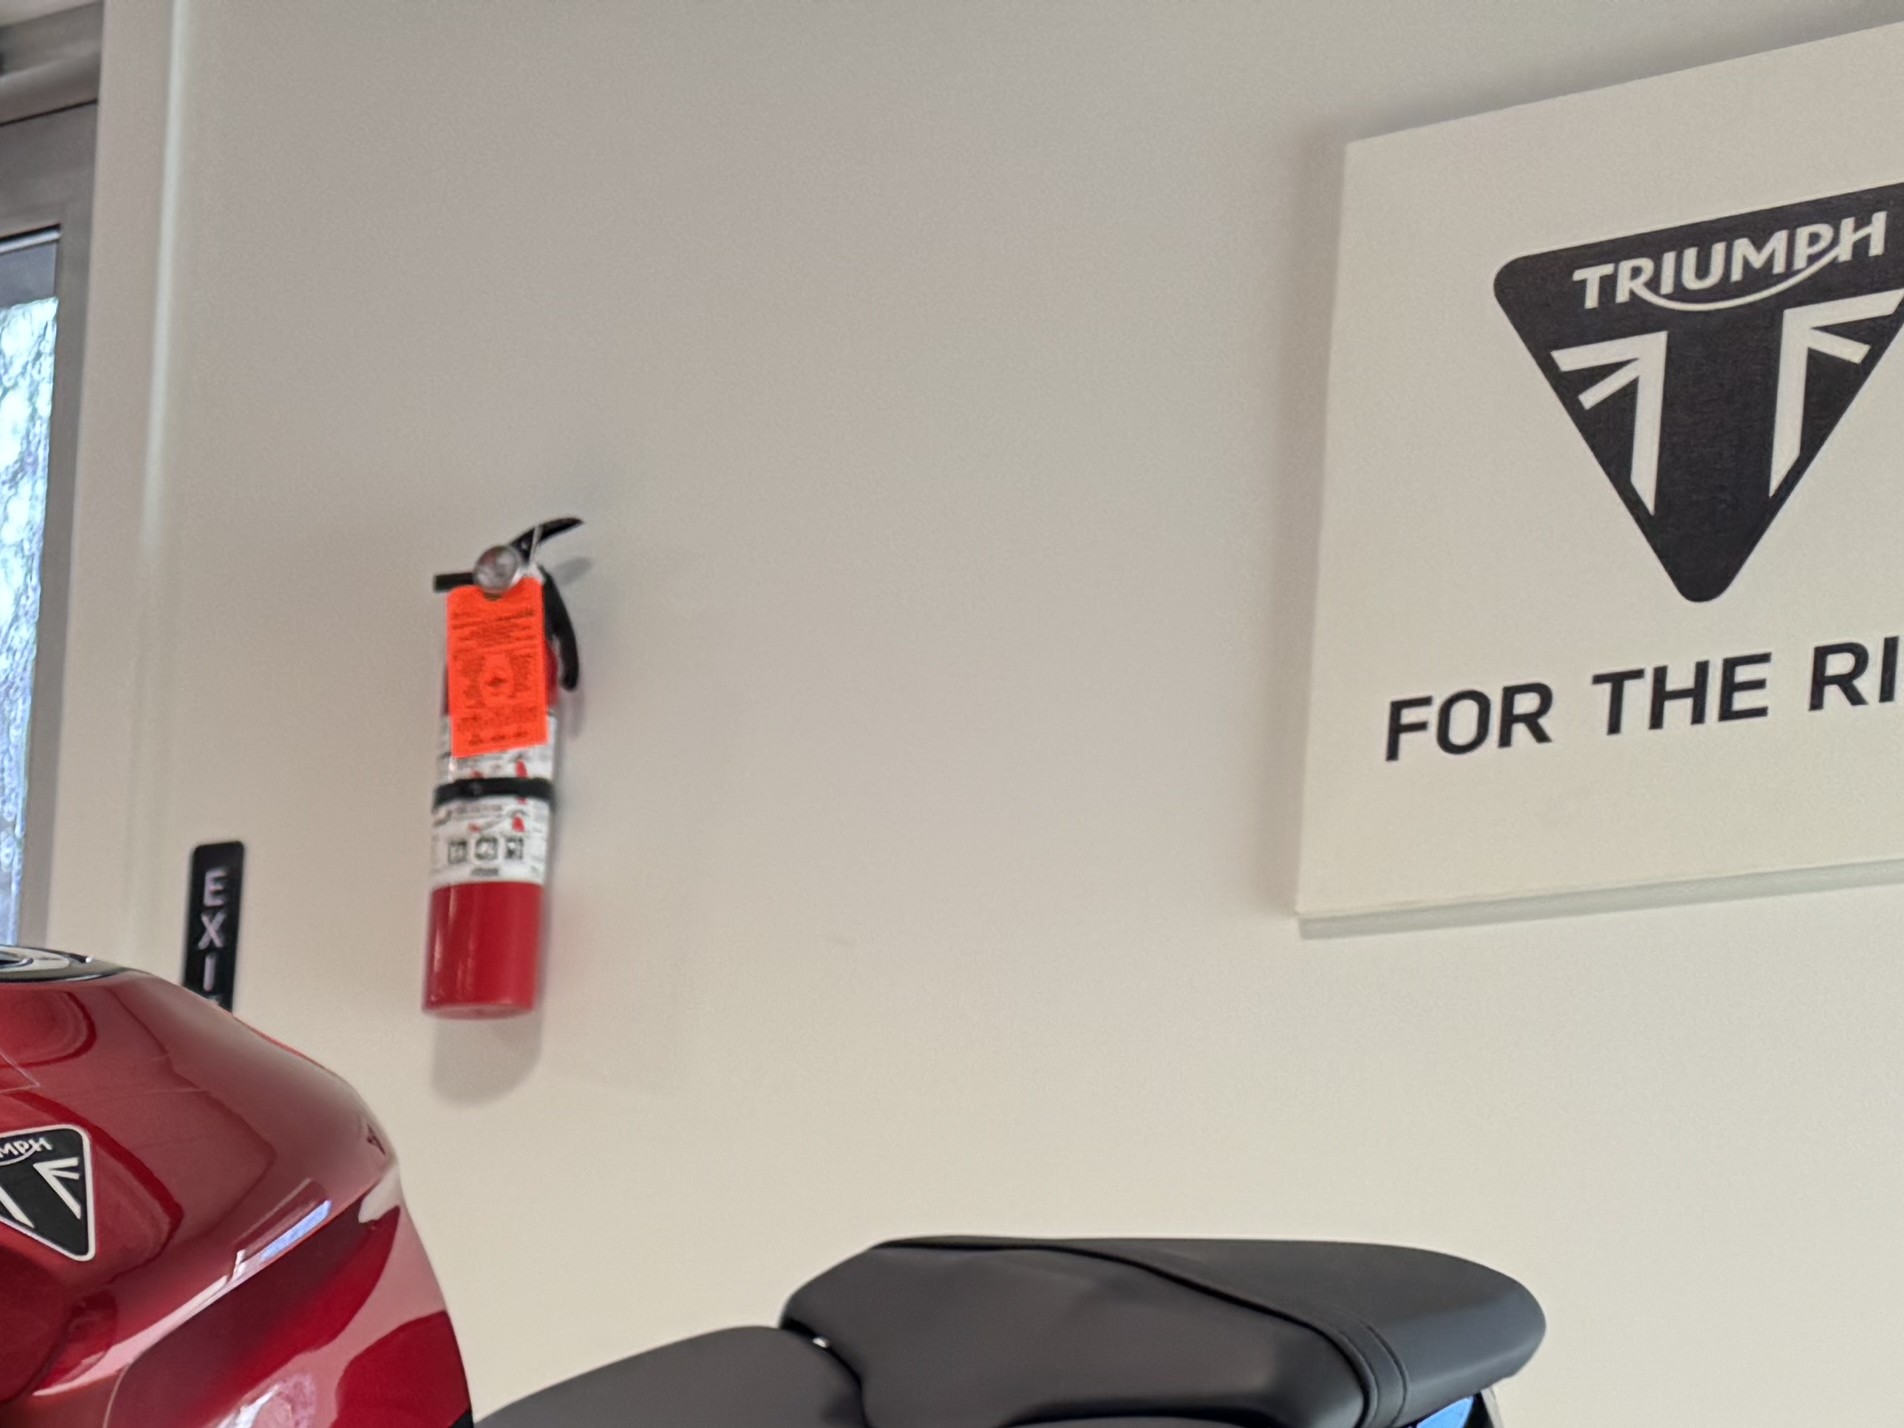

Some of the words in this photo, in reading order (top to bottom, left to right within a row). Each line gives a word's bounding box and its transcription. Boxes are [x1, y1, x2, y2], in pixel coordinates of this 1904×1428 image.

[1572, 210, 1888, 311] TRIUMPH
[1385, 682, 1553, 762] FOR
[1592, 651, 1772, 736] THE
[1808, 635, 1901, 712] RI
[197, 866, 229, 1007] EXI
